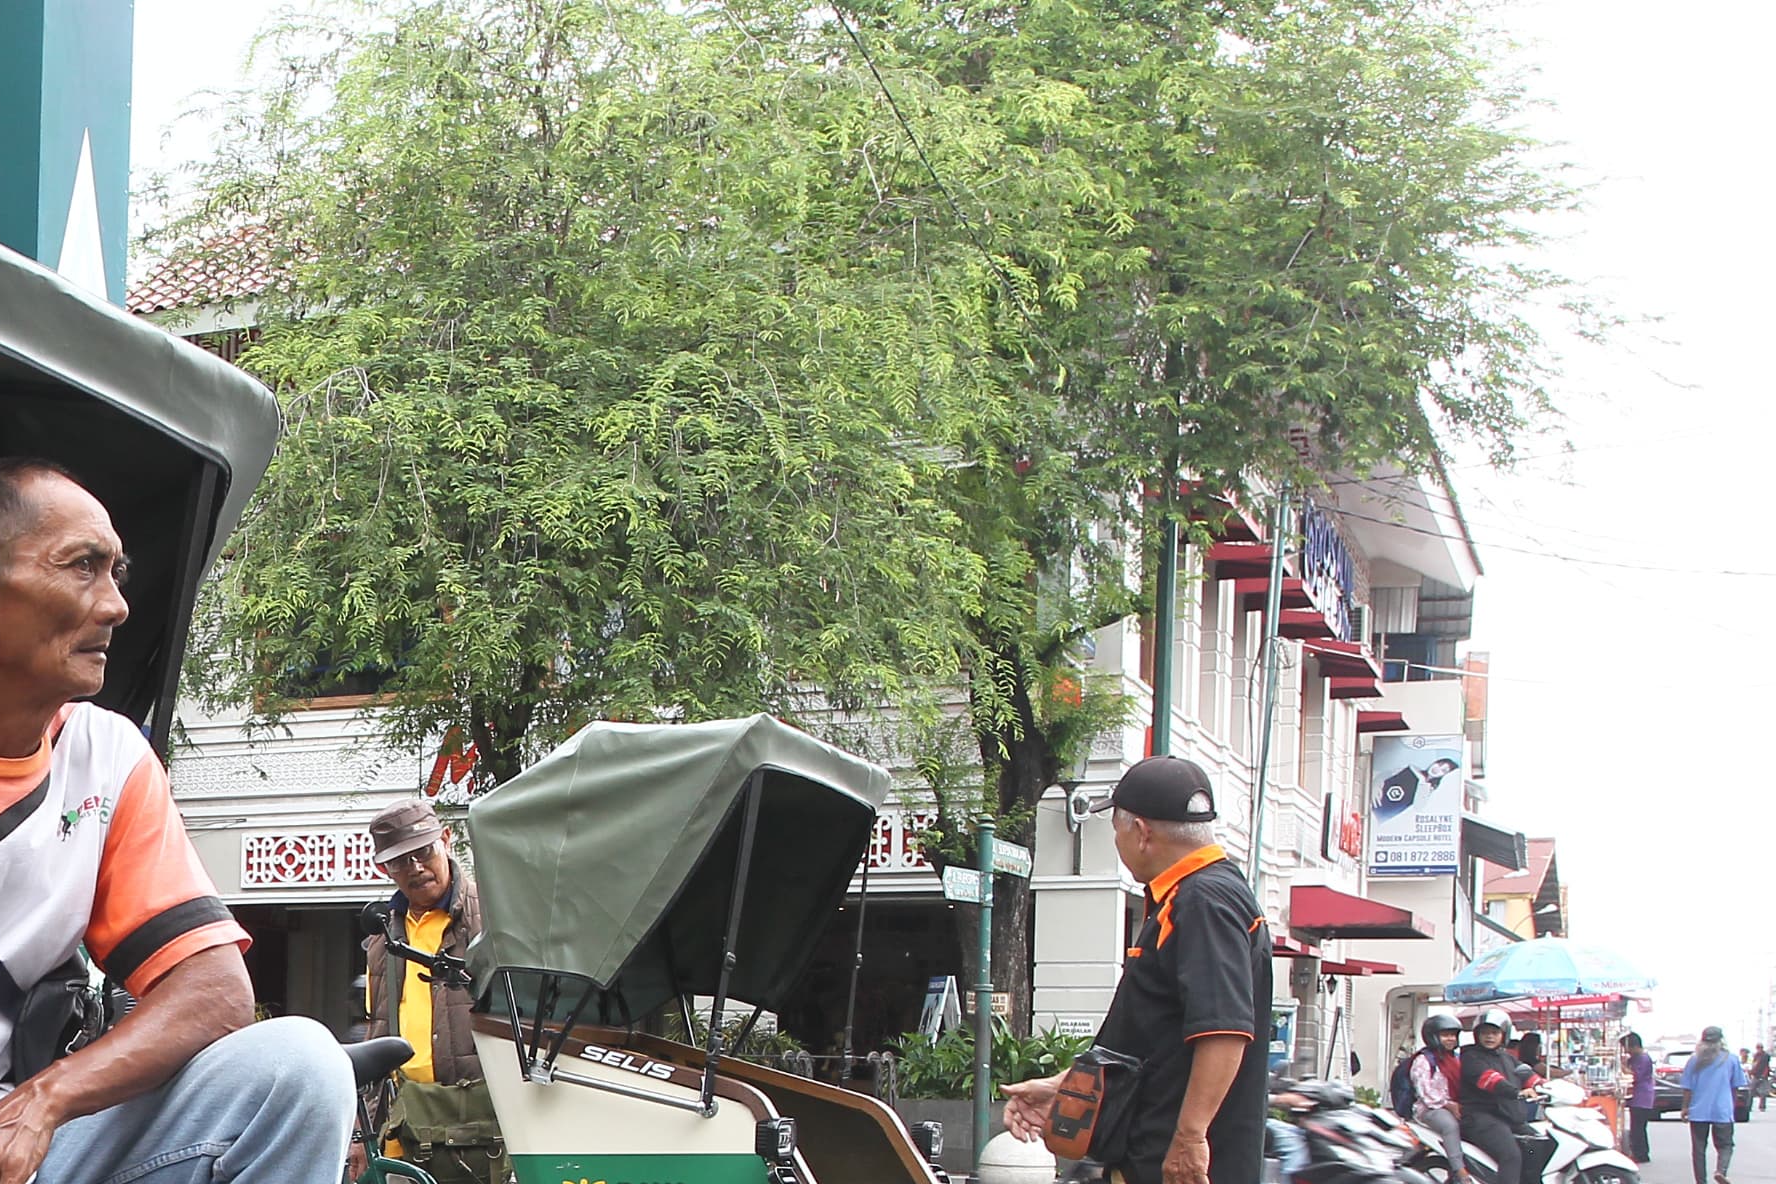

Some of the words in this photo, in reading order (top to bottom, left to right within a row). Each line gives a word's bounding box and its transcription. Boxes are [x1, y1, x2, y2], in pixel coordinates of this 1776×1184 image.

[1390, 851, 1408, 862] 081
[1410, 851, 1429, 862] 872
[1431, 850, 1455, 861] 2886
[579, 1044, 676, 1081] SELIS
